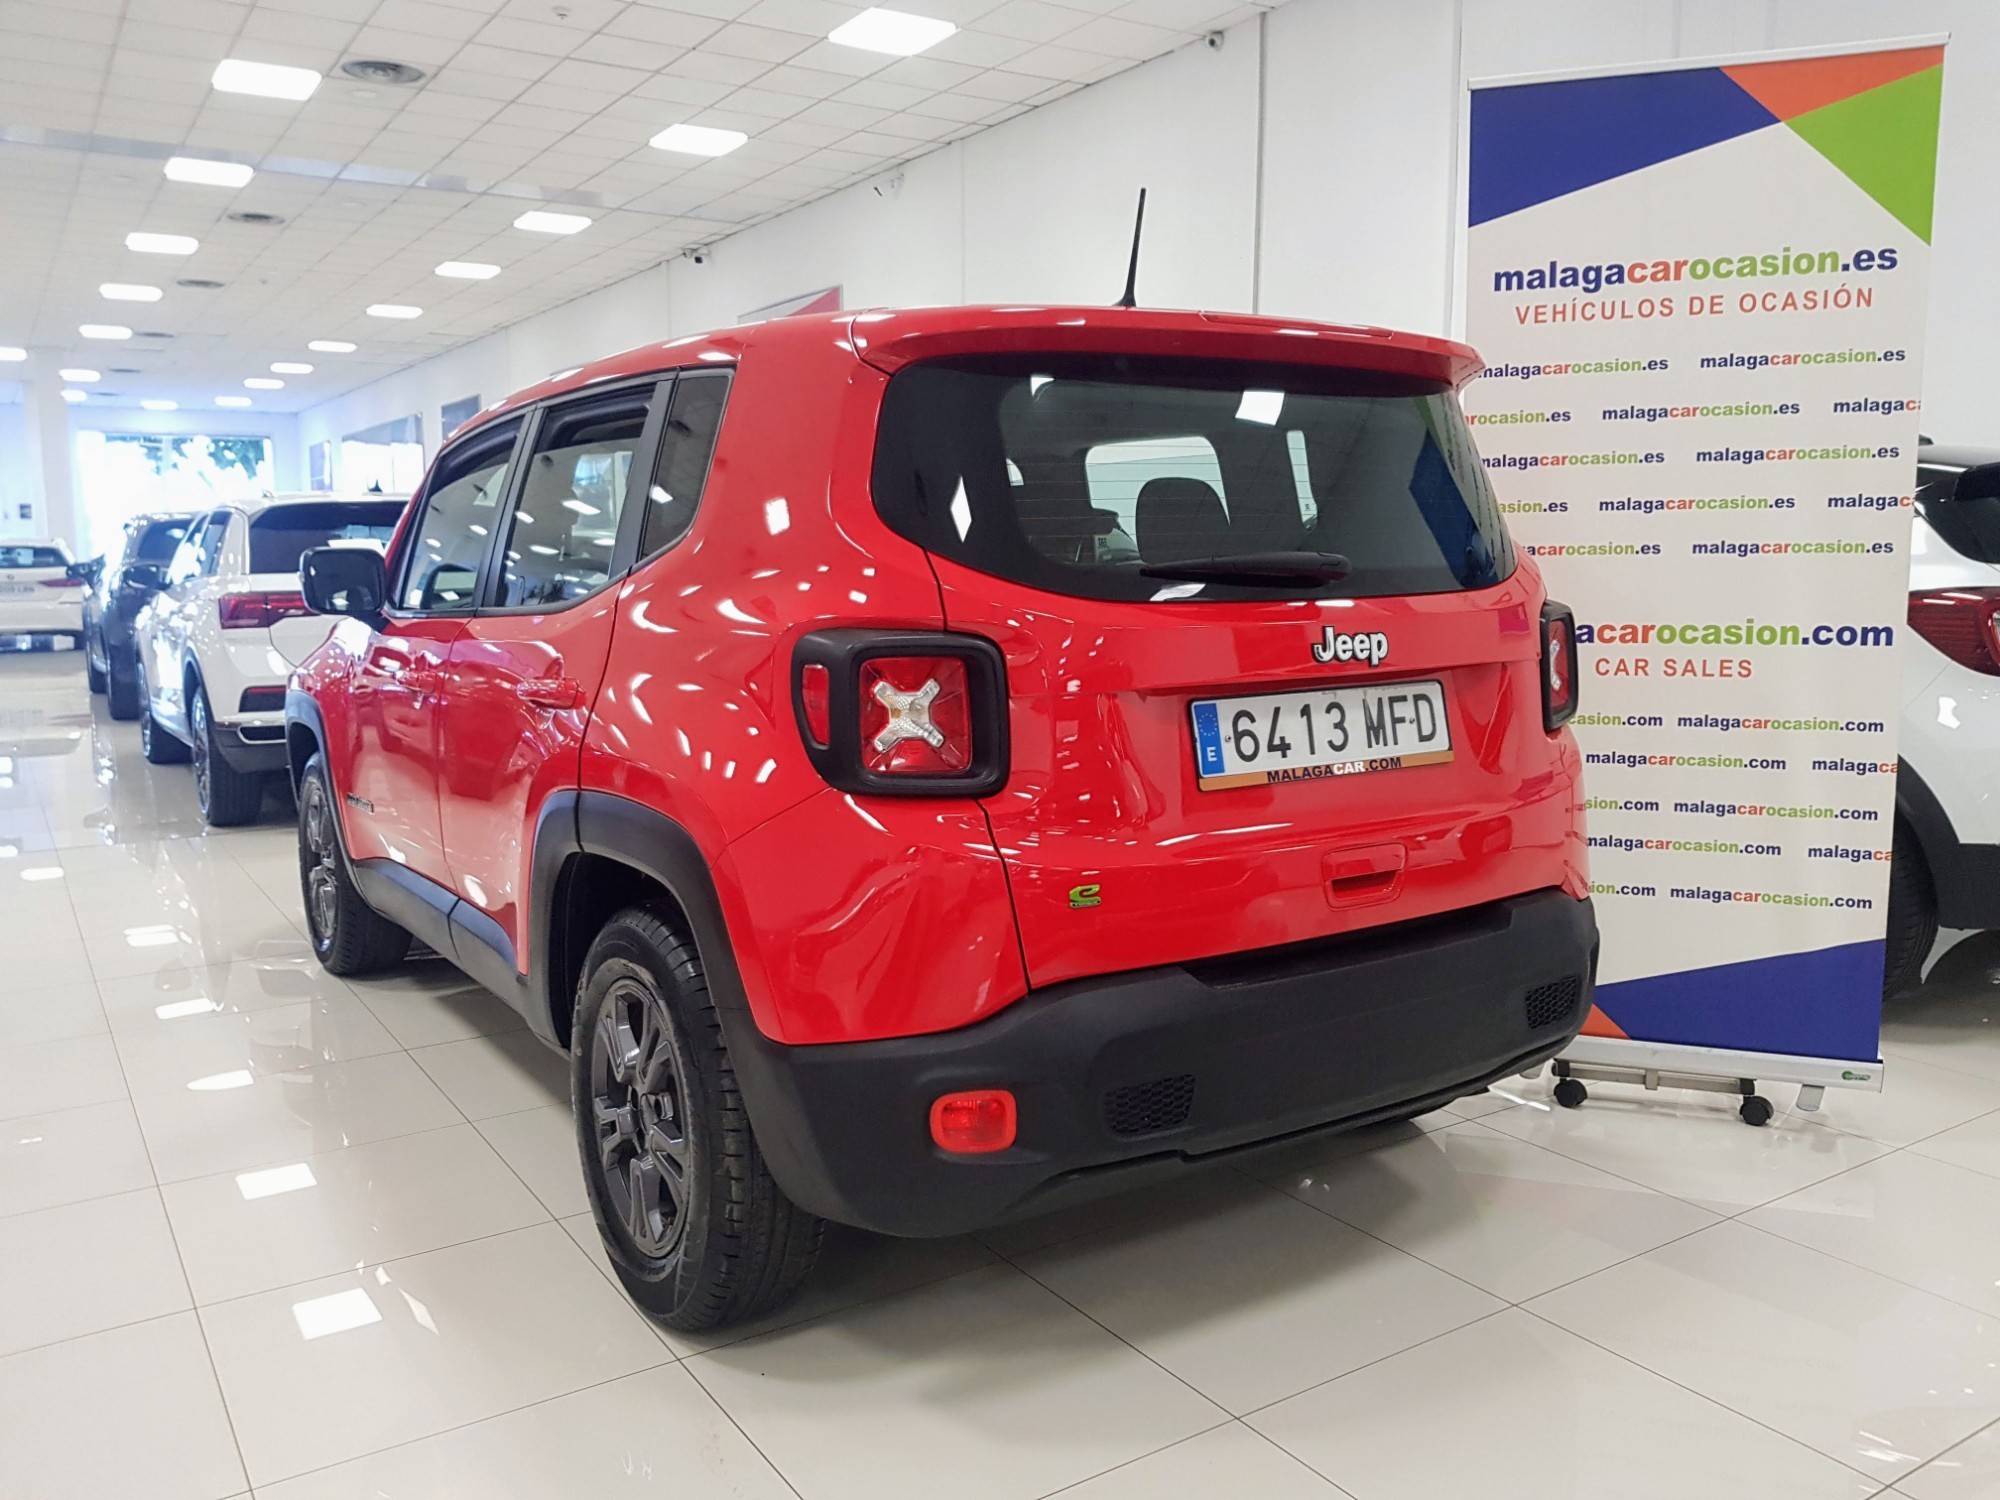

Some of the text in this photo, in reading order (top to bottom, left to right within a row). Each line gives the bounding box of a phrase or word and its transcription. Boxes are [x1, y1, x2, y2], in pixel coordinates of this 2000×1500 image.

[1494, 247, 1897, 293] malagacarocasion.es
[1516, 283, 1872, 324] VEHÍCULOS DE OCASIÓN
[1701, 349, 1905, 370] malagacarocasion.es
[1603, 402, 1800, 422] malagacarocasion.es
[1834, 398, 1919, 415] malagac
[1697, 445, 1899, 464] malagacarocasion.es
[1600, 496, 1795, 514] malagacarocasion.es
[1828, 494, 1914, 510] malagac
[1523, 540, 1893, 557] acarocasion.es malagacarocasion.es
[1313, 625, 1388, 666] Jeep
[1596, 658, 1751, 678] CAR SALES
[1232, 693, 1437, 762] 6413 MFD
[1678, 715, 1883, 732] malagacarocasion.com
[1206, 746, 1218, 762] E
[1586, 751, 1786, 769] malagacarocasion.com
[1267, 757, 1402, 783] MALAGACAR.COM
[1674, 800, 1878, 820] malagacarocasion.com
[1589, 881, 1872, 909] ion.com malagacarocasion.com
